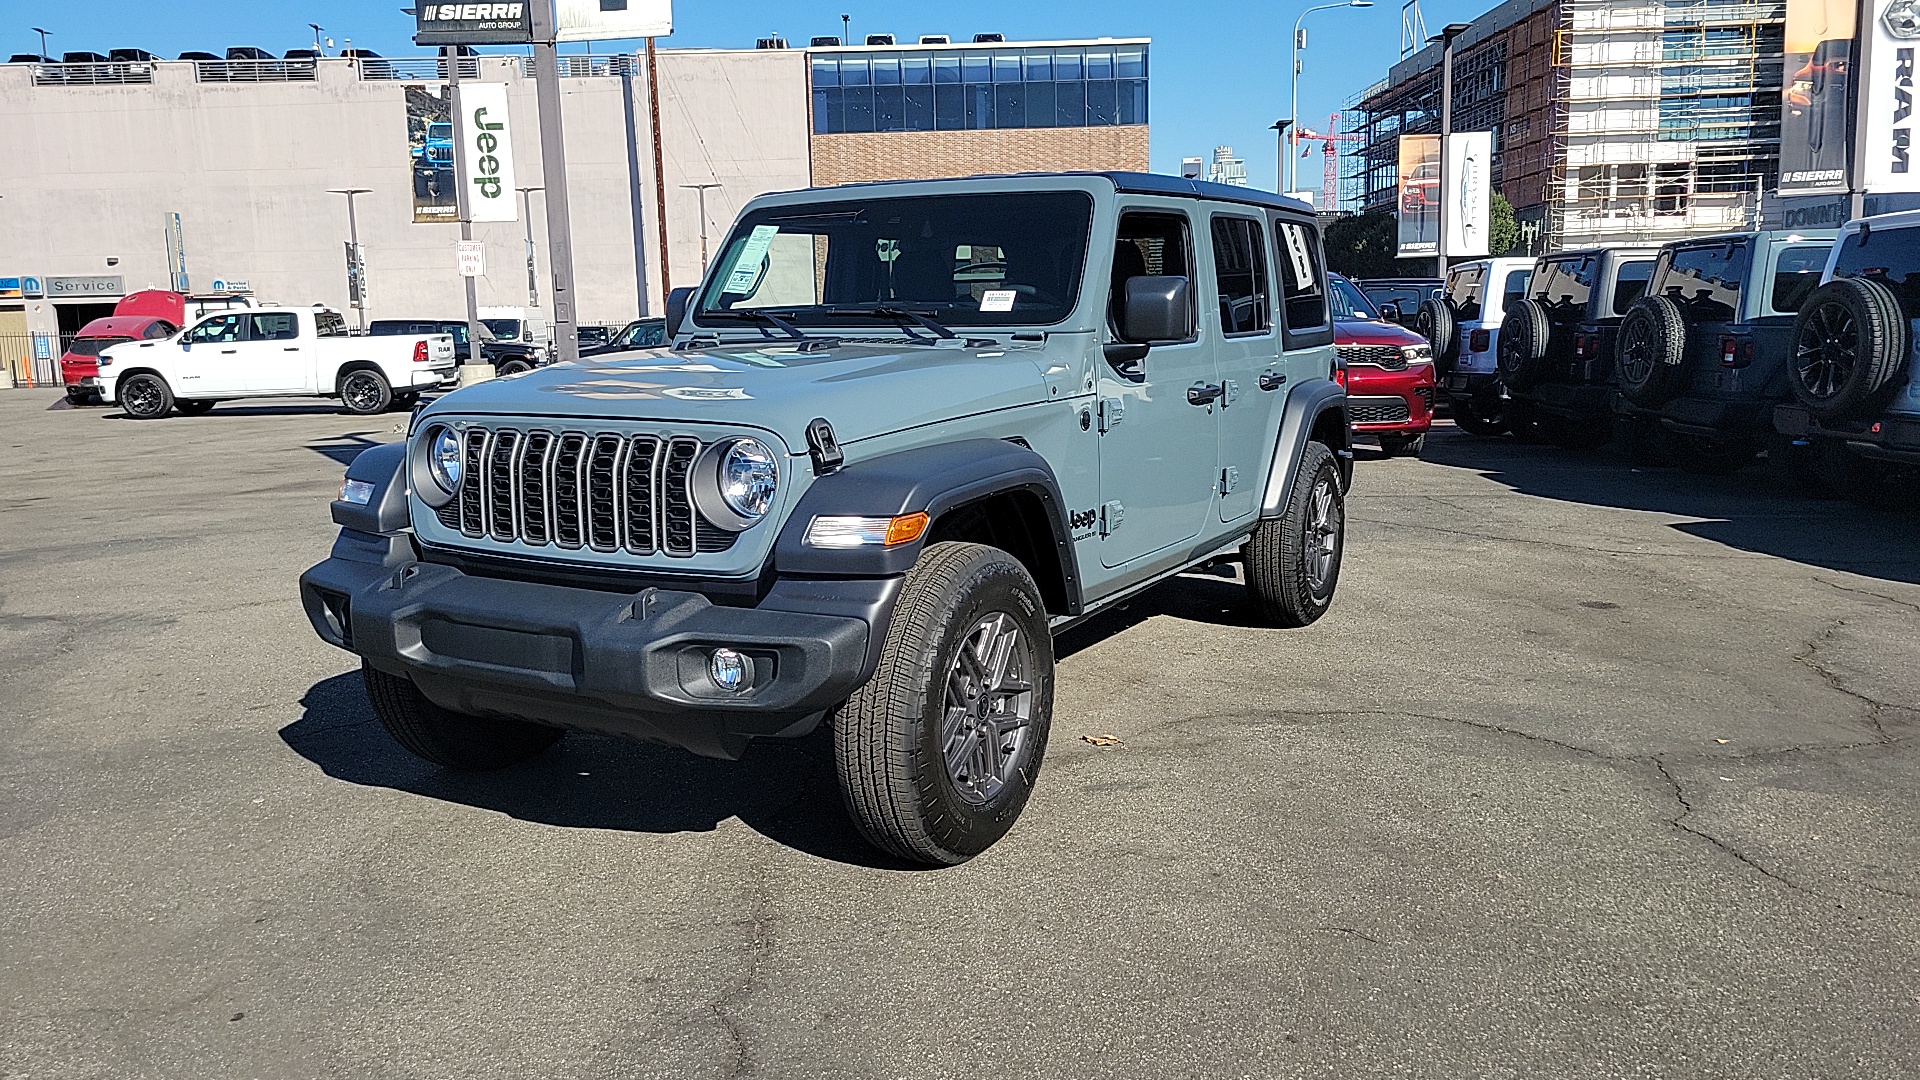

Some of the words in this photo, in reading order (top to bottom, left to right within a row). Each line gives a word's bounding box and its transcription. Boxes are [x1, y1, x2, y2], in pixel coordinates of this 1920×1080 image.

[439, 3, 523, 20] SIERRA
[498, 21, 521, 29] GROUP
[1891, 47, 1915, 173] RAM
[473, 107, 504, 198] Jeep
[1792, 170, 1843, 182] SIERRA
[461, 254, 480, 262] PARKING
[54, 280, 115, 291] Service
[1069, 508, 1097, 529] Jeep
